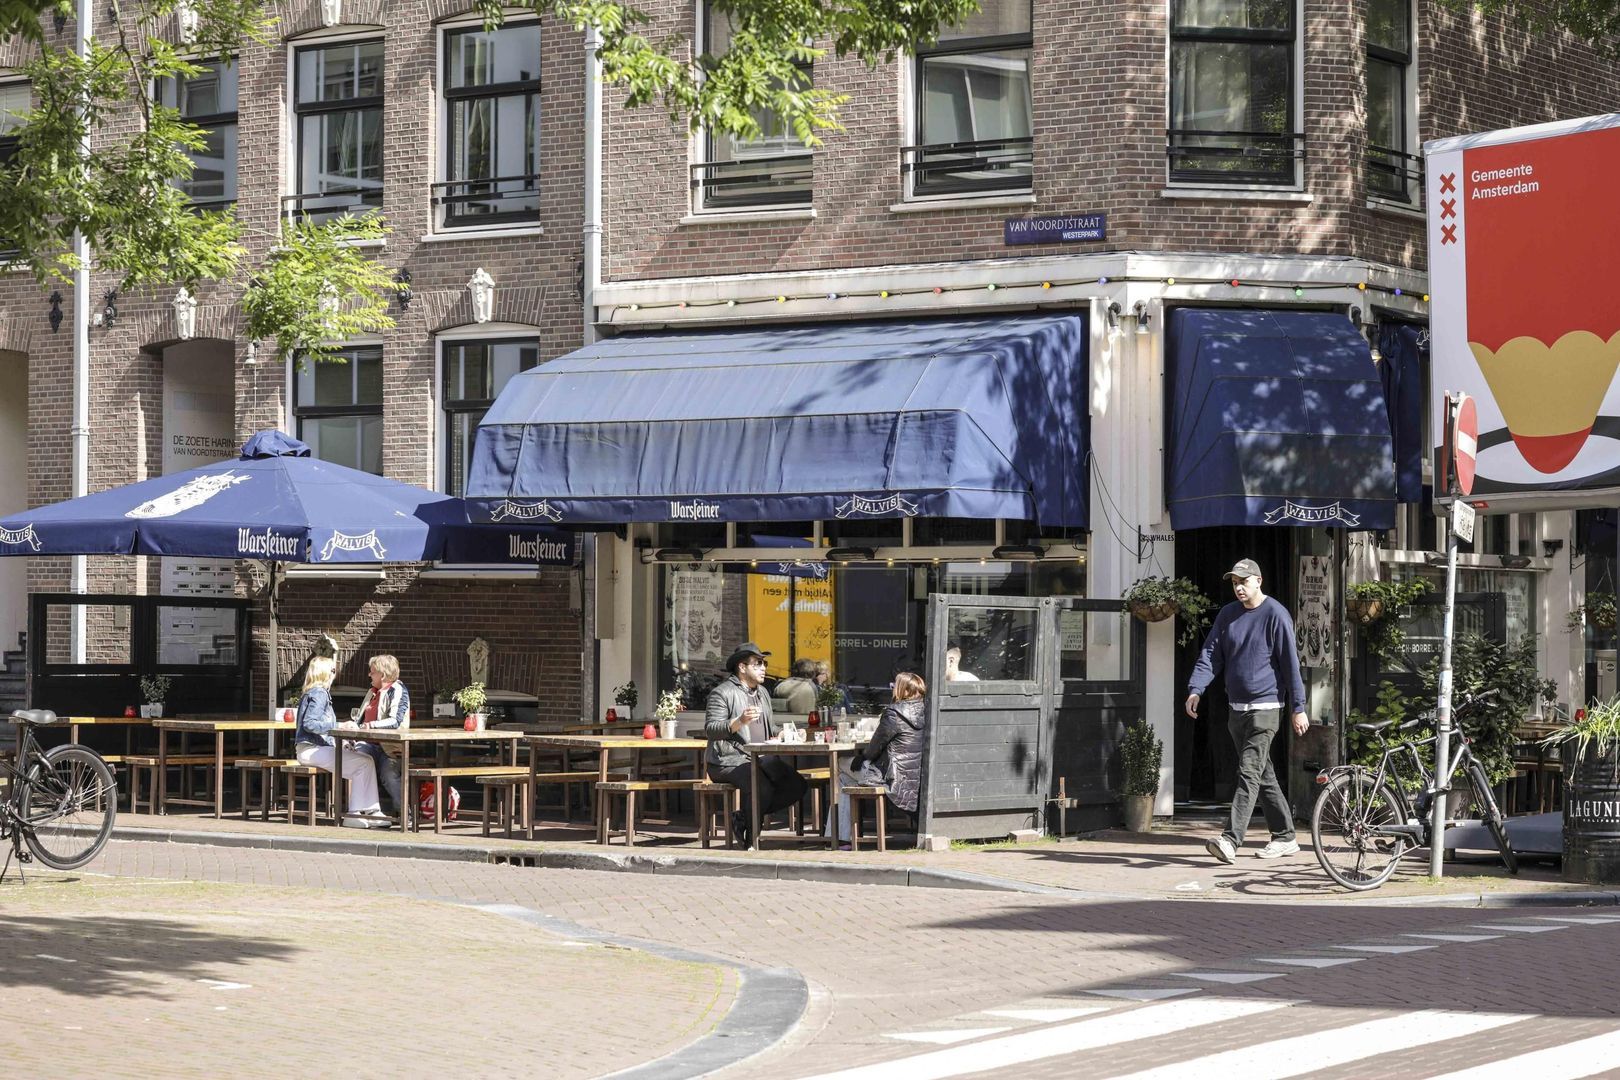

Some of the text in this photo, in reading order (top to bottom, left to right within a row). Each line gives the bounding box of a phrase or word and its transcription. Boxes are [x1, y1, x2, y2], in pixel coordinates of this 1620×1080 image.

[1471, 164, 1533, 182] Gemeente
[1471, 180, 1539, 200] Amsterdam
[1009, 217, 1101, 232] VAN NOORDTSTRAAT
[1062, 230, 1099, 239] WESTERPARK
[173, 435, 236, 448] DE ZOETE HARIN
[173, 448, 234, 458] VAN NOORDTSTRAAT
[508, 503, 545, 517] WALVIS
[670, 499, 720, 520] Warsteiner
[855, 498, 897, 512] WALVIS
[1288, 505, 1336, 519] WALVIS
[0, 528, 29, 542] WALVIS
[238, 527, 299, 557] Warsteiner
[335, 533, 373, 549] WALVIS
[509, 533, 567, 562] Warsteiner
[834, 638, 908, 649] ORREL-DINER
